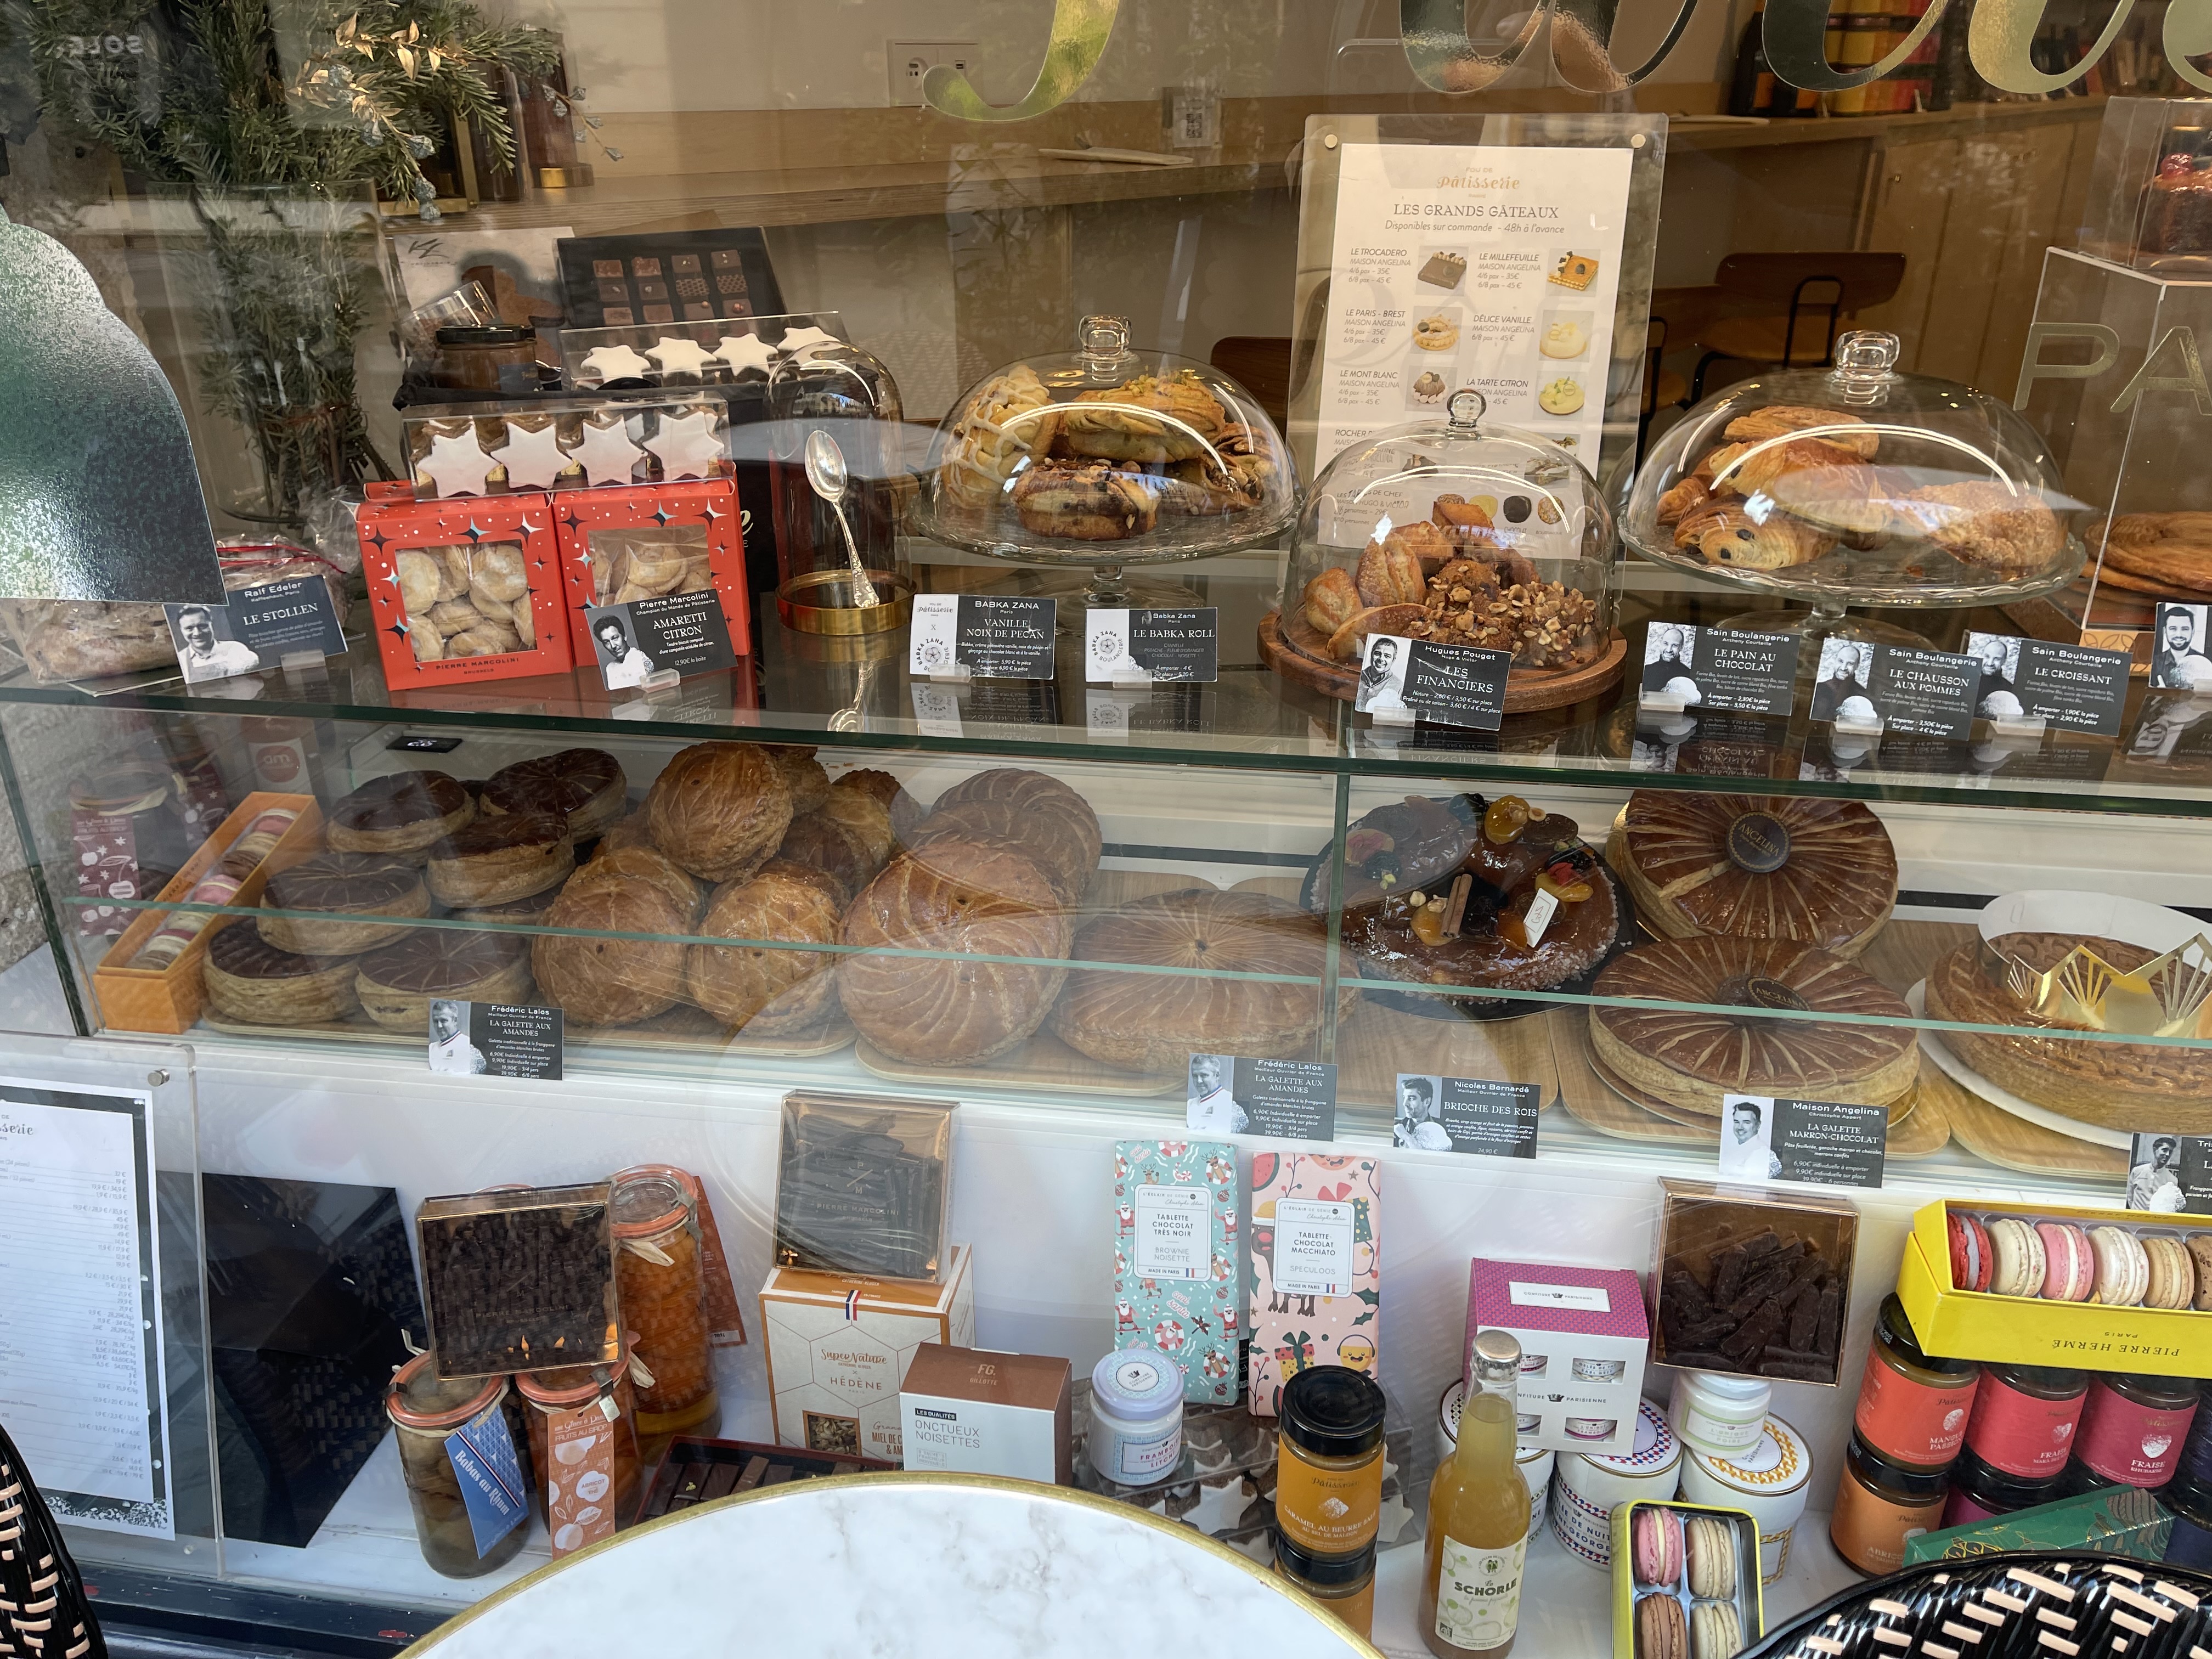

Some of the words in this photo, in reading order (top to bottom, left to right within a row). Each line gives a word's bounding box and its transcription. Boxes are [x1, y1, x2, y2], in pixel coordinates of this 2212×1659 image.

[1436, 175, 1520, 189] Pâtisserie
[1394, 204, 1419, 215] LES
[1424, 205, 1483, 217] GRANDS
[1489, 205, 1559, 218] GÂTEAUX
[1385, 220, 1430, 232] Disponibles
[1448, 223, 1492, 232] commande
[1531, 224, 1564, 233] l'avance
[1474, 314, 1500, 323] DÉLICE
[244, 588, 266, 598] Ralf
[639, 601, 667, 609] Pierre
[670, 592, 709, 605] Marcolini
[242, 616, 260, 625] LE
[262, 603, 318, 622] STOLLEN
[653, 612, 707, 629] AMARETTI
[663, 625, 702, 640] CITRON
[967, 629, 991, 637] NOIX
[1731, 631, 1790, 642] Boulangerie
[1099, 638, 1124, 662] BOULANGERIE
[1425, 645, 1459, 656] Hugues
[1463, 651, 1496, 660] Pouget
[1715, 648, 1727, 657] LE
[1731, 651, 1757, 659] PAIN
[1760, 653, 1776, 661] AU
[2032, 647, 2055, 656] Sain
[2059, 650, 2121, 665] Boulangerie
[471, 658, 519, 666] MARCOLINI
[1889, 649, 1911, 658] Sain
[1916, 652, 1977, 666] Boulangerie
[1445, 666, 1468, 676] LES
[1716, 660, 1773, 672] CHOCOLAT
[1889, 669, 1904, 678] LE
[1907, 672, 1970, 686] CHAUSSON
[2035, 668, 2049, 676] LE
[2051, 670, 2112, 684] CROISSANT
[1417, 675, 1493, 692] FINANCIERS
[1894, 681, 1916, 690] AUX
[1919, 684, 1961, 696] POMMES
[1739, 823, 1780, 857] ANGELINA
[1258, 1060, 1295, 1069] Frédéric
[1268, 1076, 1304, 1085] GALETTE
[1455, 1081, 1486, 1090] Nicolas
[1489, 1084, 1530, 1093] Bernardé
[1268, 1085, 1308, 1093] AMANDES
[1444, 1102, 1488, 1113] BRIOCHE
[1492, 1106, 1511, 1114] DES
[1514, 1108, 1537, 1116] ROIS
[1793, 1103, 1829, 1112] Maison
[1833, 1106, 1879, 1115] Angelina
[1822, 1125, 1861, 1133] GALETTE
[1790, 1131, 1879, 1144] MARRON-CHOCOLAT
[1294, 1239, 1334, 1248] CHOCOLAT
[1291, 1248, 1335, 1256] MACCHIATO
[1290, 1266, 1335, 1274] SPECULOOS
[1166, 1300, 1190, 1319] santa
[2052, 1339, 2112, 1352] HERMÉ
[2119, 1345, 2180, 1356] PIERRE
[831, 1375, 882, 1390] HÉDÈNE
[916, 1420, 979, 1437] ONCTUEUX
[555, 1432, 577, 1441] FRUITS
[872, 1432, 887, 1442] MIEL
[889, 1434, 898, 1443] DE
[916, 1431, 980, 1448] NOISETTES
[2131, 1459, 2165, 1468] FRAISE
[455, 1450, 482, 1481] Babas
[478, 1479, 492, 1493] au
[489, 1489, 510, 1515] Rhum
[582, 1479, 605, 1488] ABRICOT
[1284, 1505, 1316, 1529] CARAMEL
[1332, 1522, 1362, 1533] BEURRE
[1572, 1516, 1582, 1528] DE
[1454, 1577, 1517, 1596] SCHORLE
